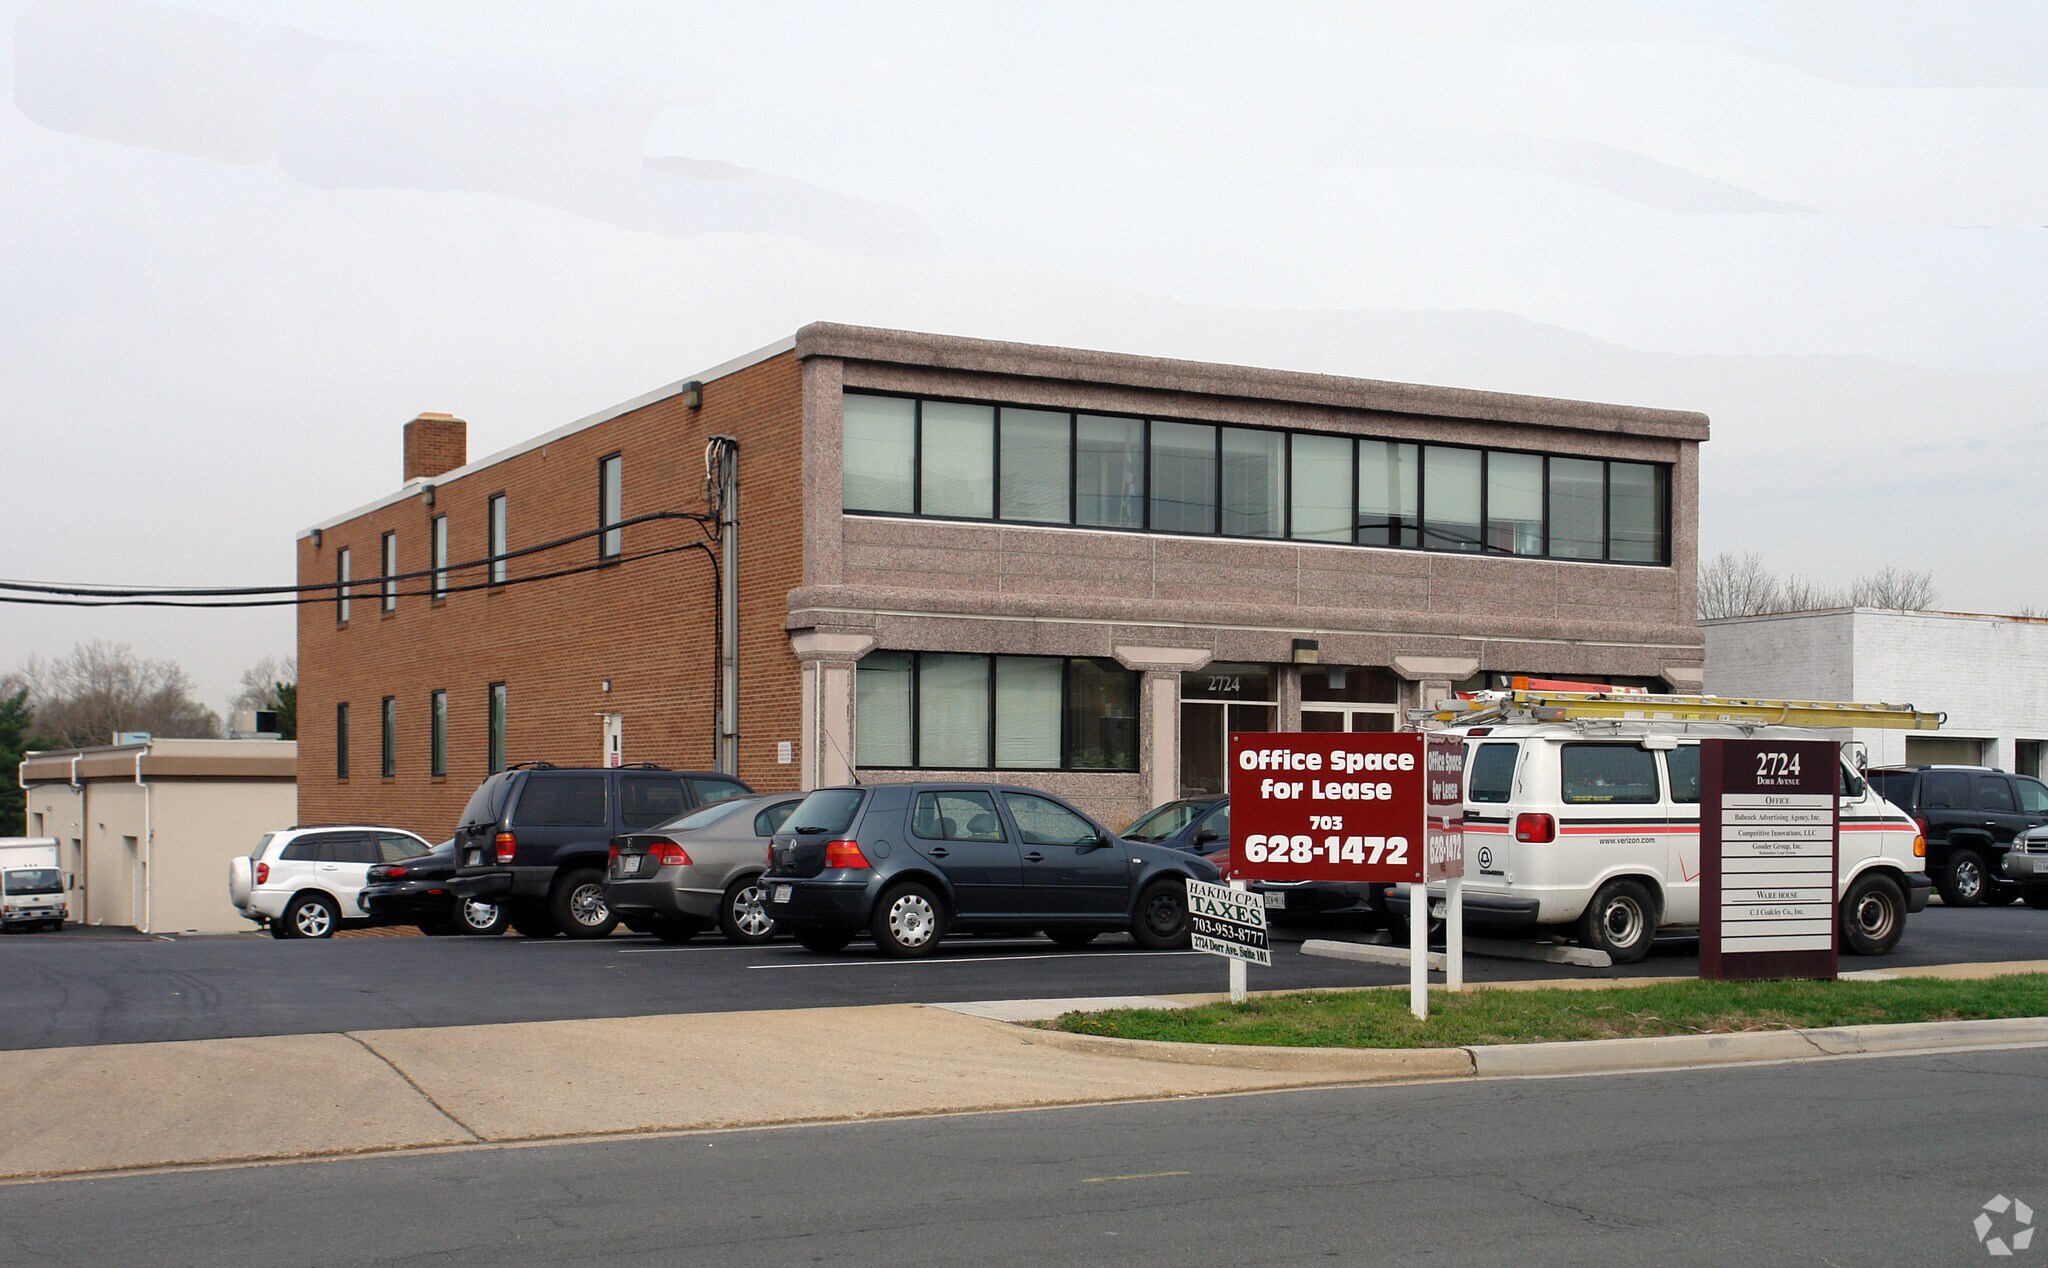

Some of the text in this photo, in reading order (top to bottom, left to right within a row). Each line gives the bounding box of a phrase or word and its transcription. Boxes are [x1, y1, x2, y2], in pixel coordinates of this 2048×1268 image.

[1208, 676, 1240, 691] 2724
[1239, 749, 1415, 774] Office Space
[1428, 751, 1462, 774] Office Space
[1756, 752, 1801, 776] 2724
[1260, 778, 1392, 801] for Lease
[1442, 781, 1458, 800] Lease
[1757, 776, 1800, 785] DORR AVENUE
[1765, 796, 1791, 805] OFFICE
[1309, 815, 1343, 831] 703
[1759, 814, 1789, 822] Advertising
[1599, 836, 1656, 845] www.verizon.com
[1738, 829, 1770, 838] Competitive
[1245, 834, 1408, 865] 628-1472
[1430, 833, 1462, 864] 628-1472
[1190, 883, 1232, 902] HAKIM
[1191, 895, 1262, 926] TAXES
[1193, 917, 1264, 945] 703-953-8777
[1194, 936, 1268, 963] 2724 Dorr Ave. Suite 101
